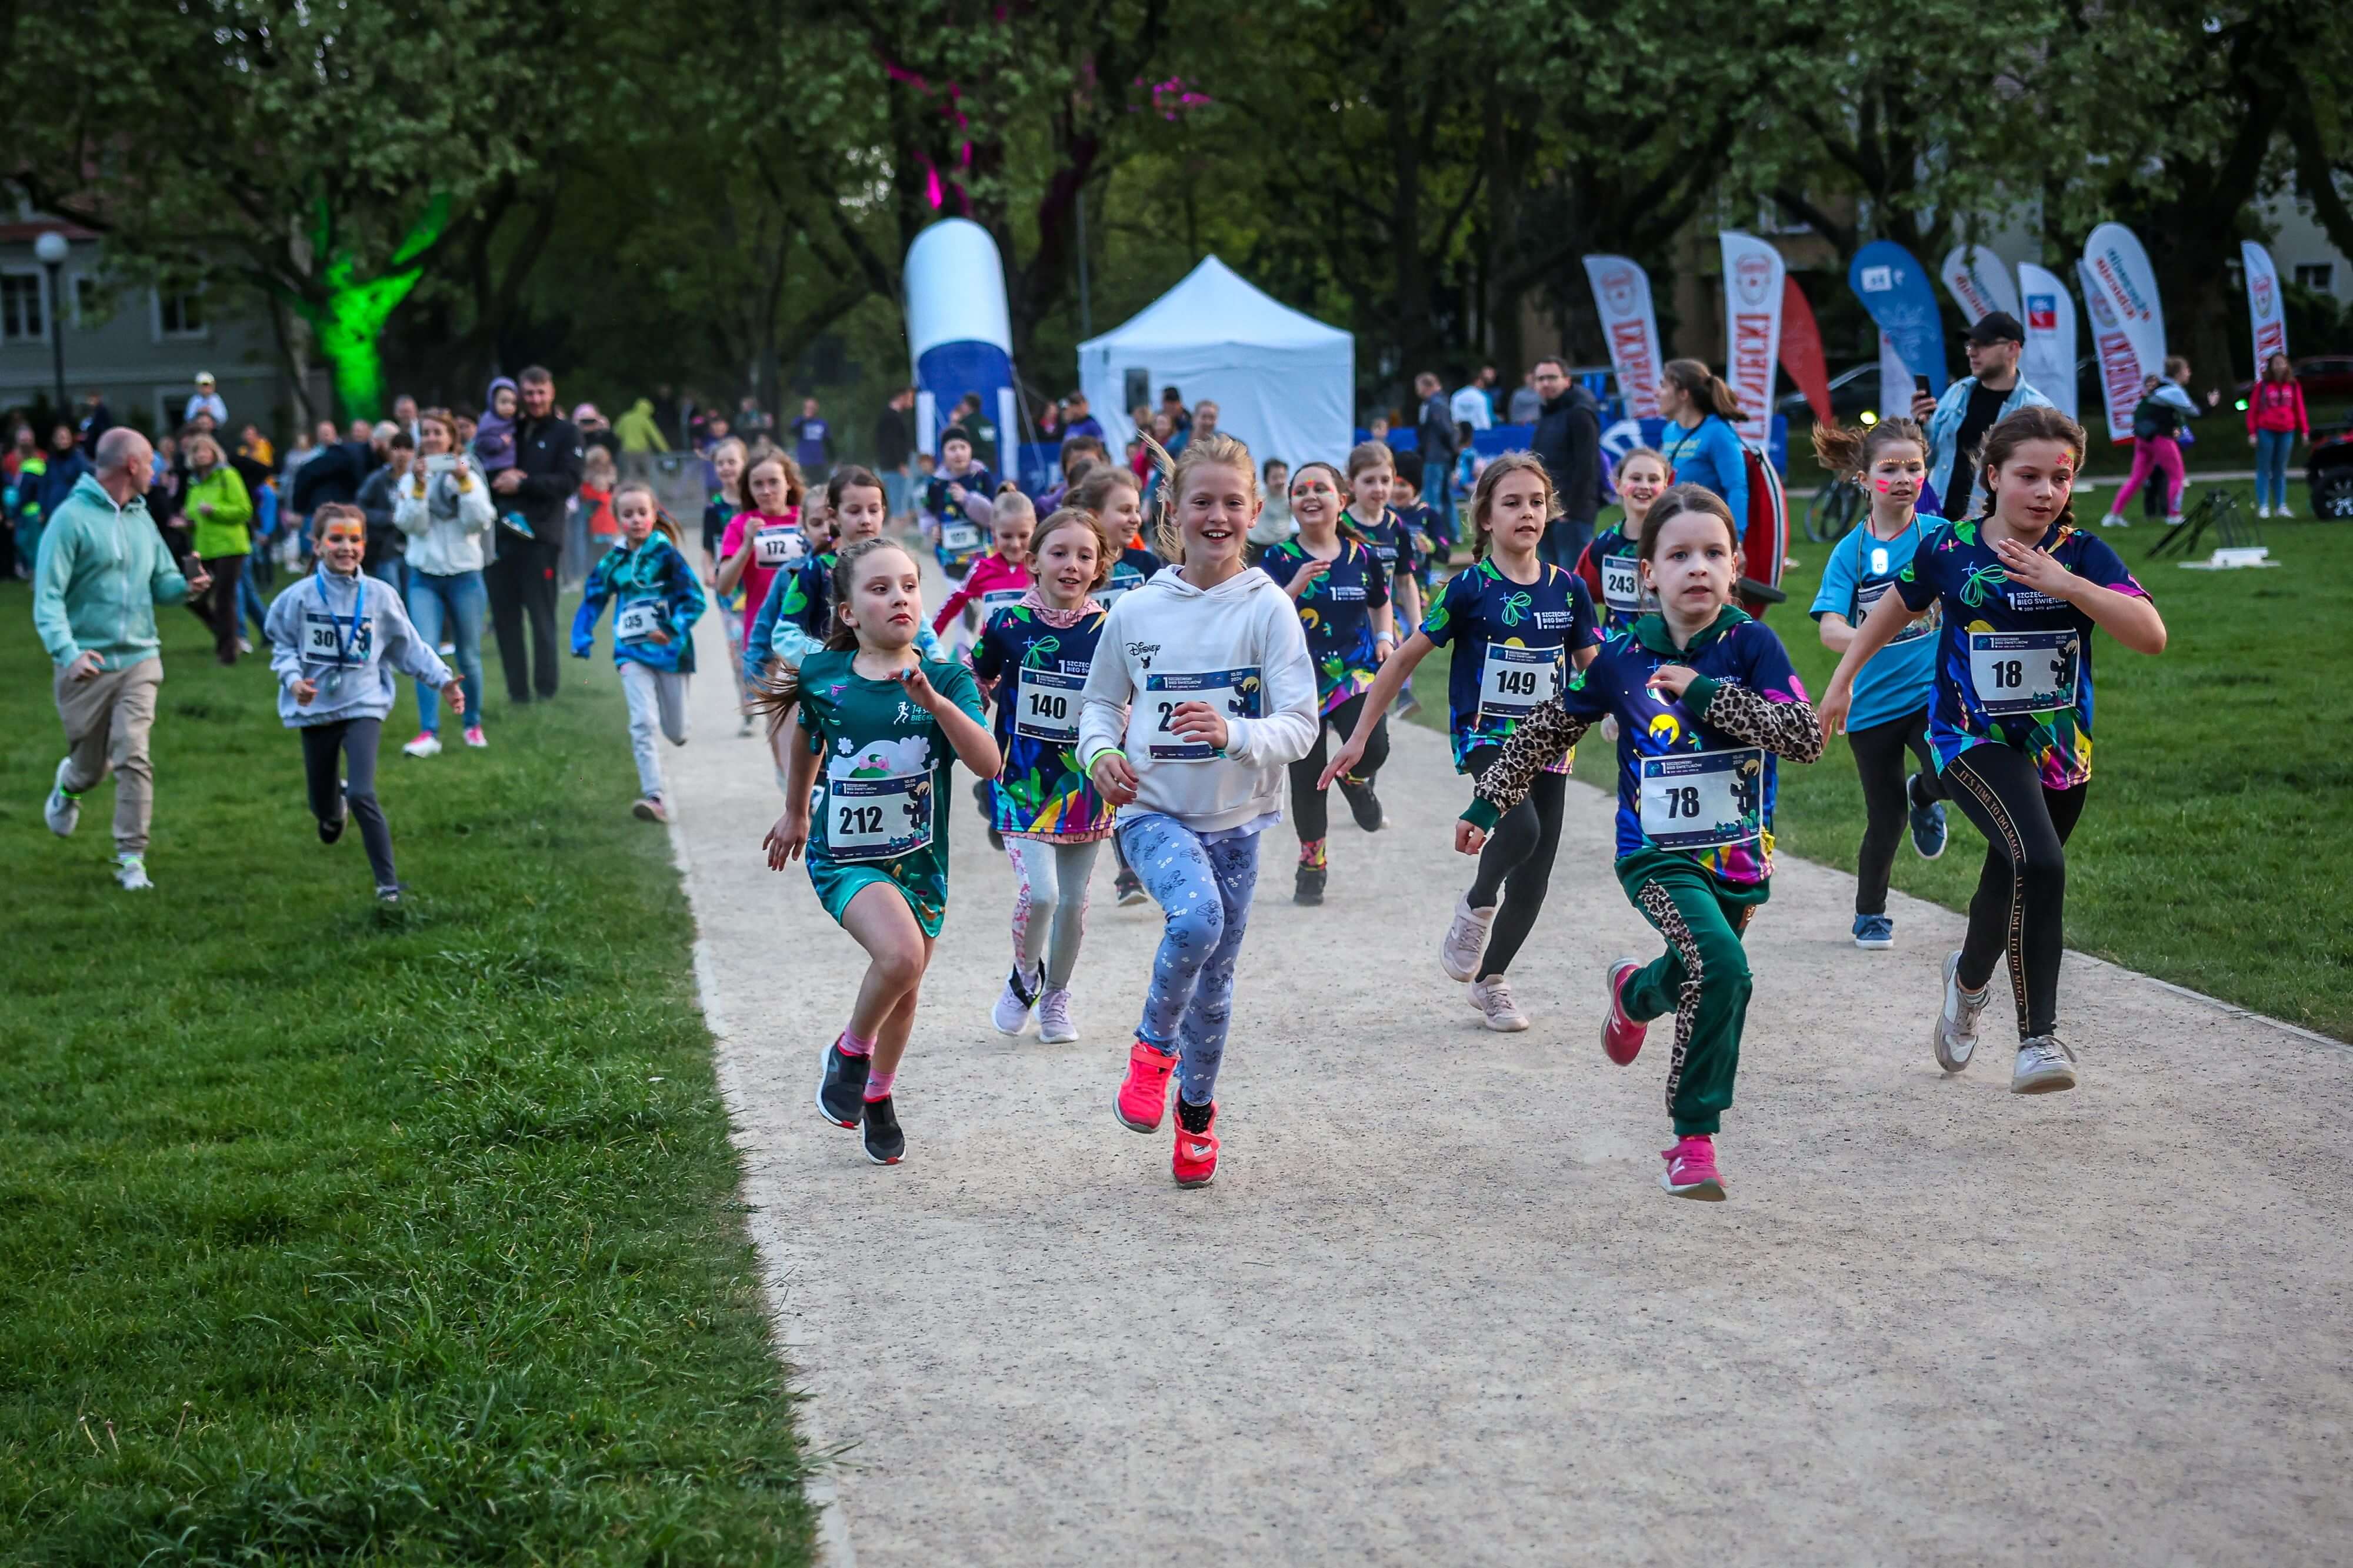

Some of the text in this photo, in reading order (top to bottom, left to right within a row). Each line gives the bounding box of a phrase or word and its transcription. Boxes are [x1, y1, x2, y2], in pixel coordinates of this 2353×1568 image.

[766, 541, 786, 556] 172
[1609, 574, 1635, 593] 243
[1496, 670, 1537, 695] 149
[1991, 660, 2022, 688] 18
[912, 704, 922, 714] 14
[1029, 693, 1067, 720] 140
[1665, 786, 1700, 819] 78
[1959, 770, 1976, 787] IT'S
[1975, 783, 1992, 803] TIME
[1990, 801, 2001, 816] TO
[1998, 815, 2009, 830] DO
[839, 806, 884, 835] 212
[2012, 955, 2020, 971] DO
